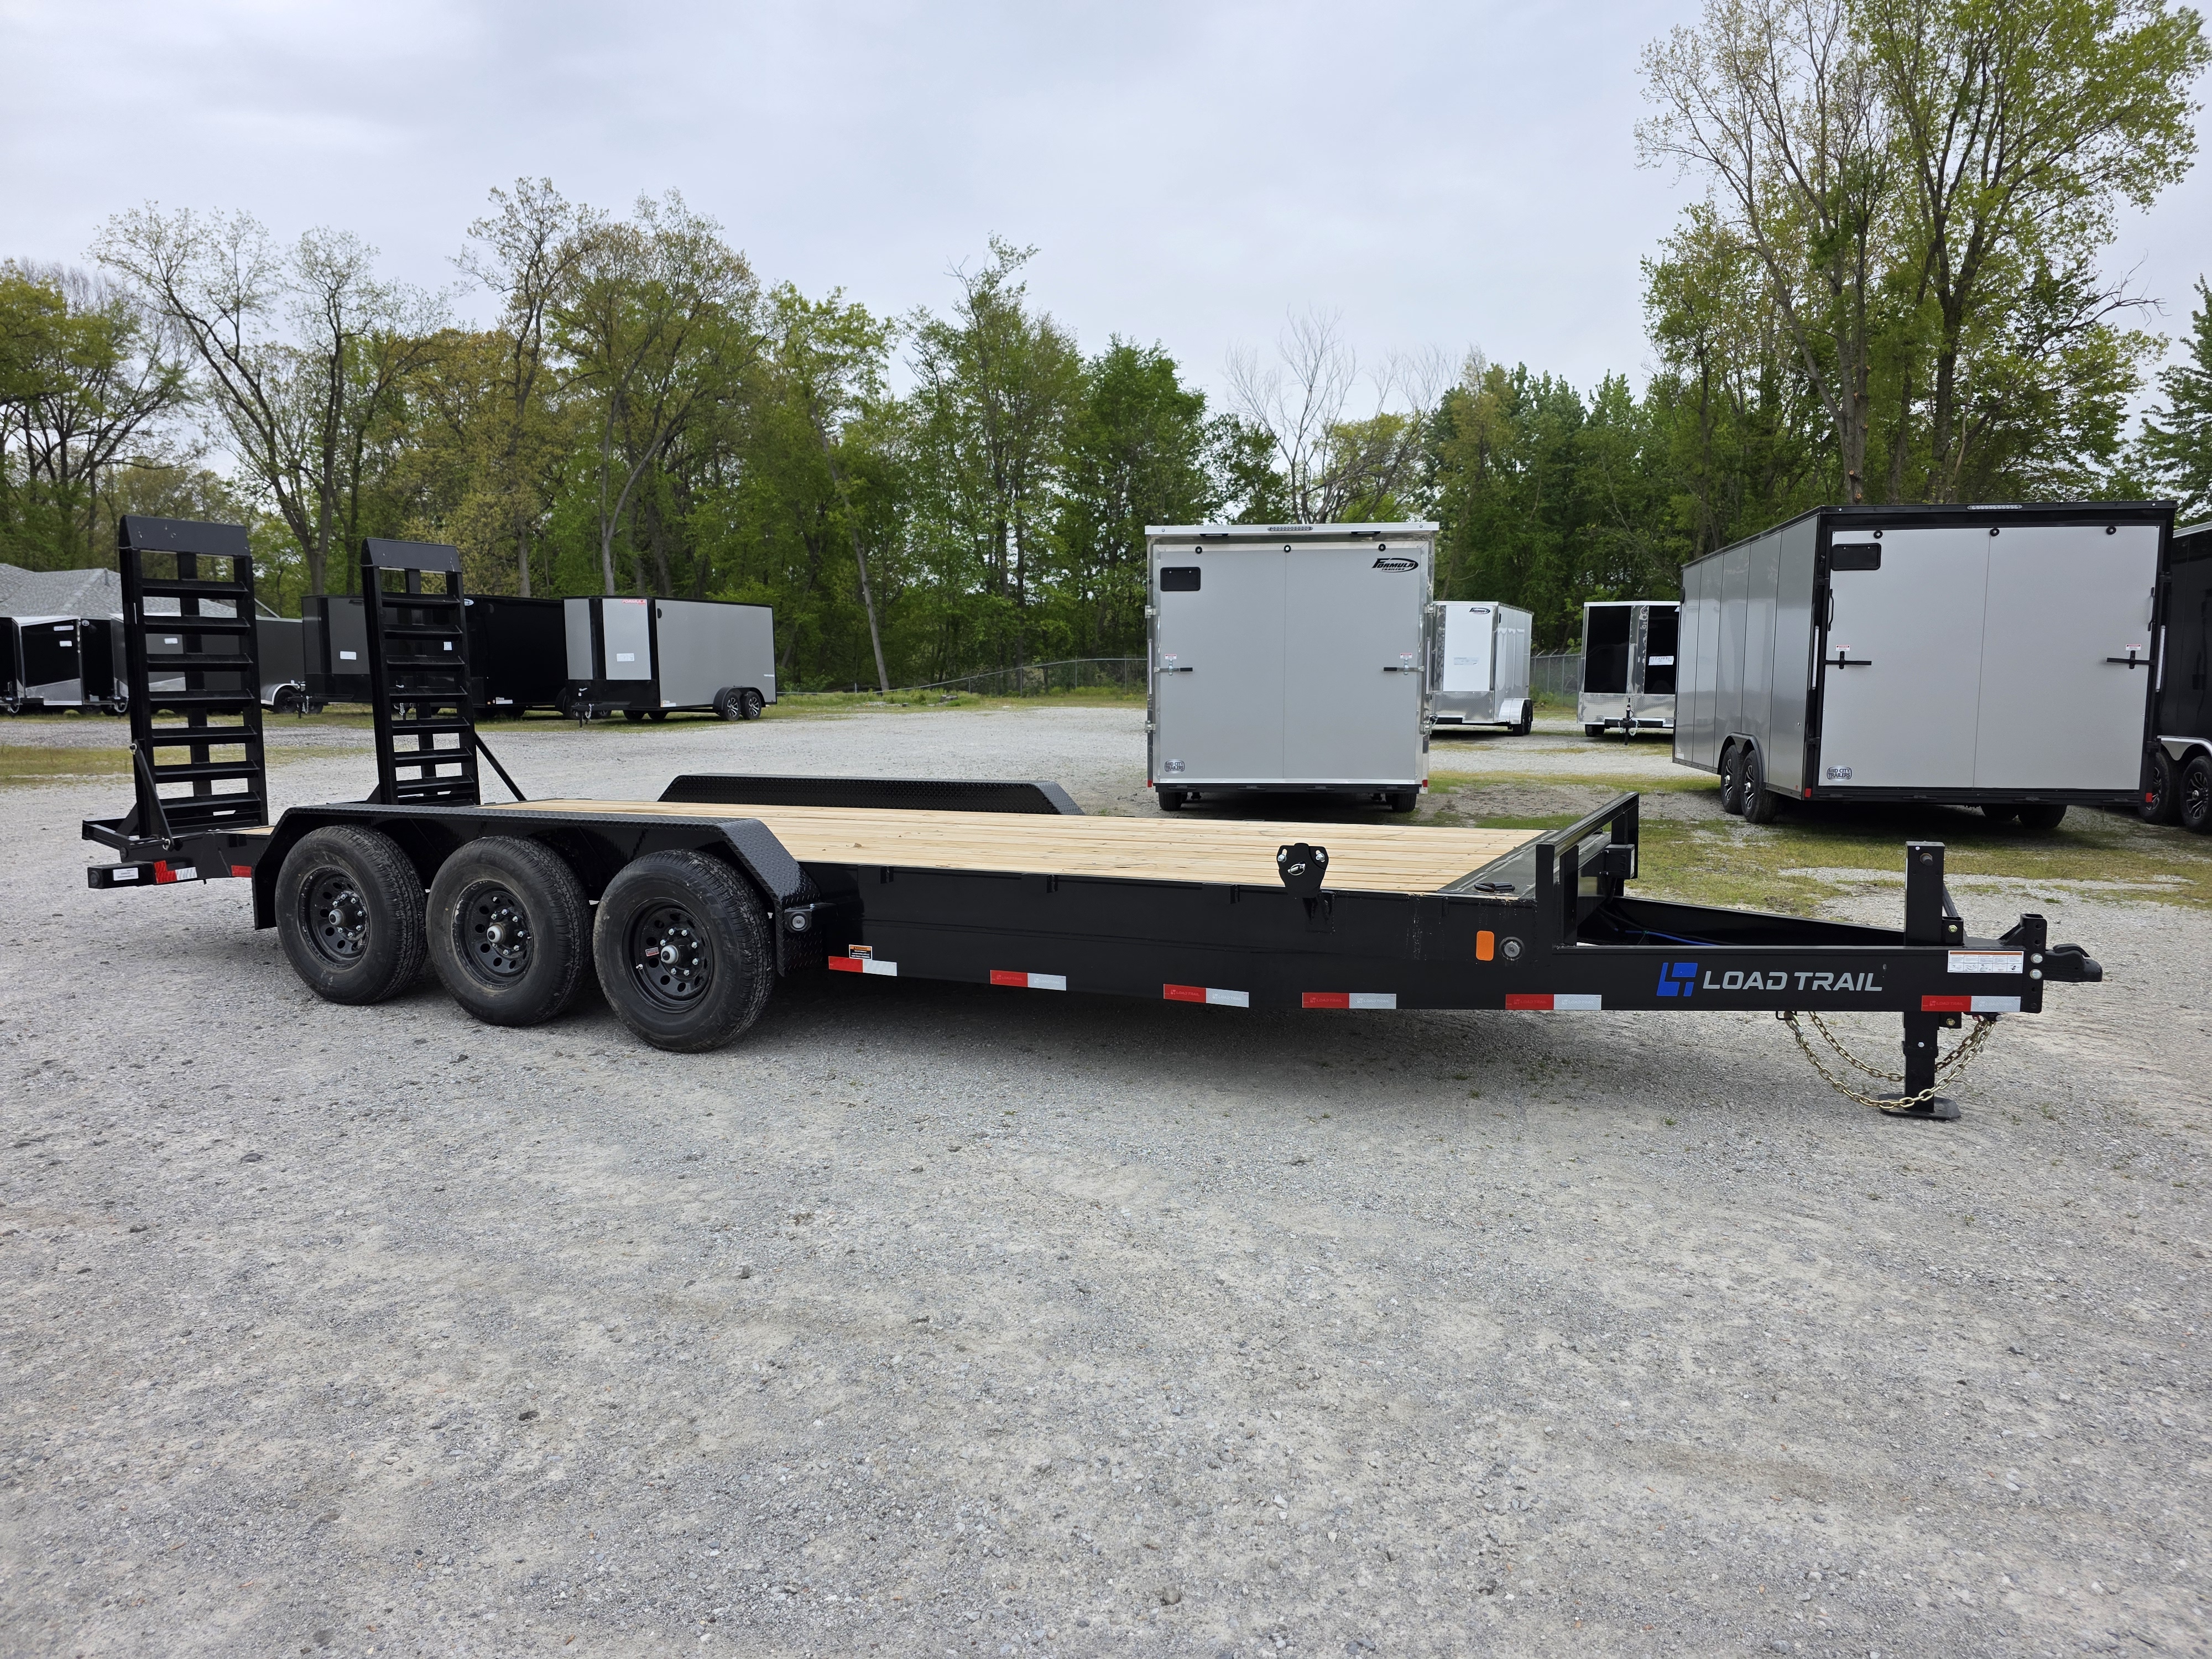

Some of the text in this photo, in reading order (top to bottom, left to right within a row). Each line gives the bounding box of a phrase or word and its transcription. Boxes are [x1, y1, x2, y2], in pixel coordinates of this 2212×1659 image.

[1371, 558, 1414, 568] FORMULA
[1703, 971, 1882, 991] LOAD TRAIL
